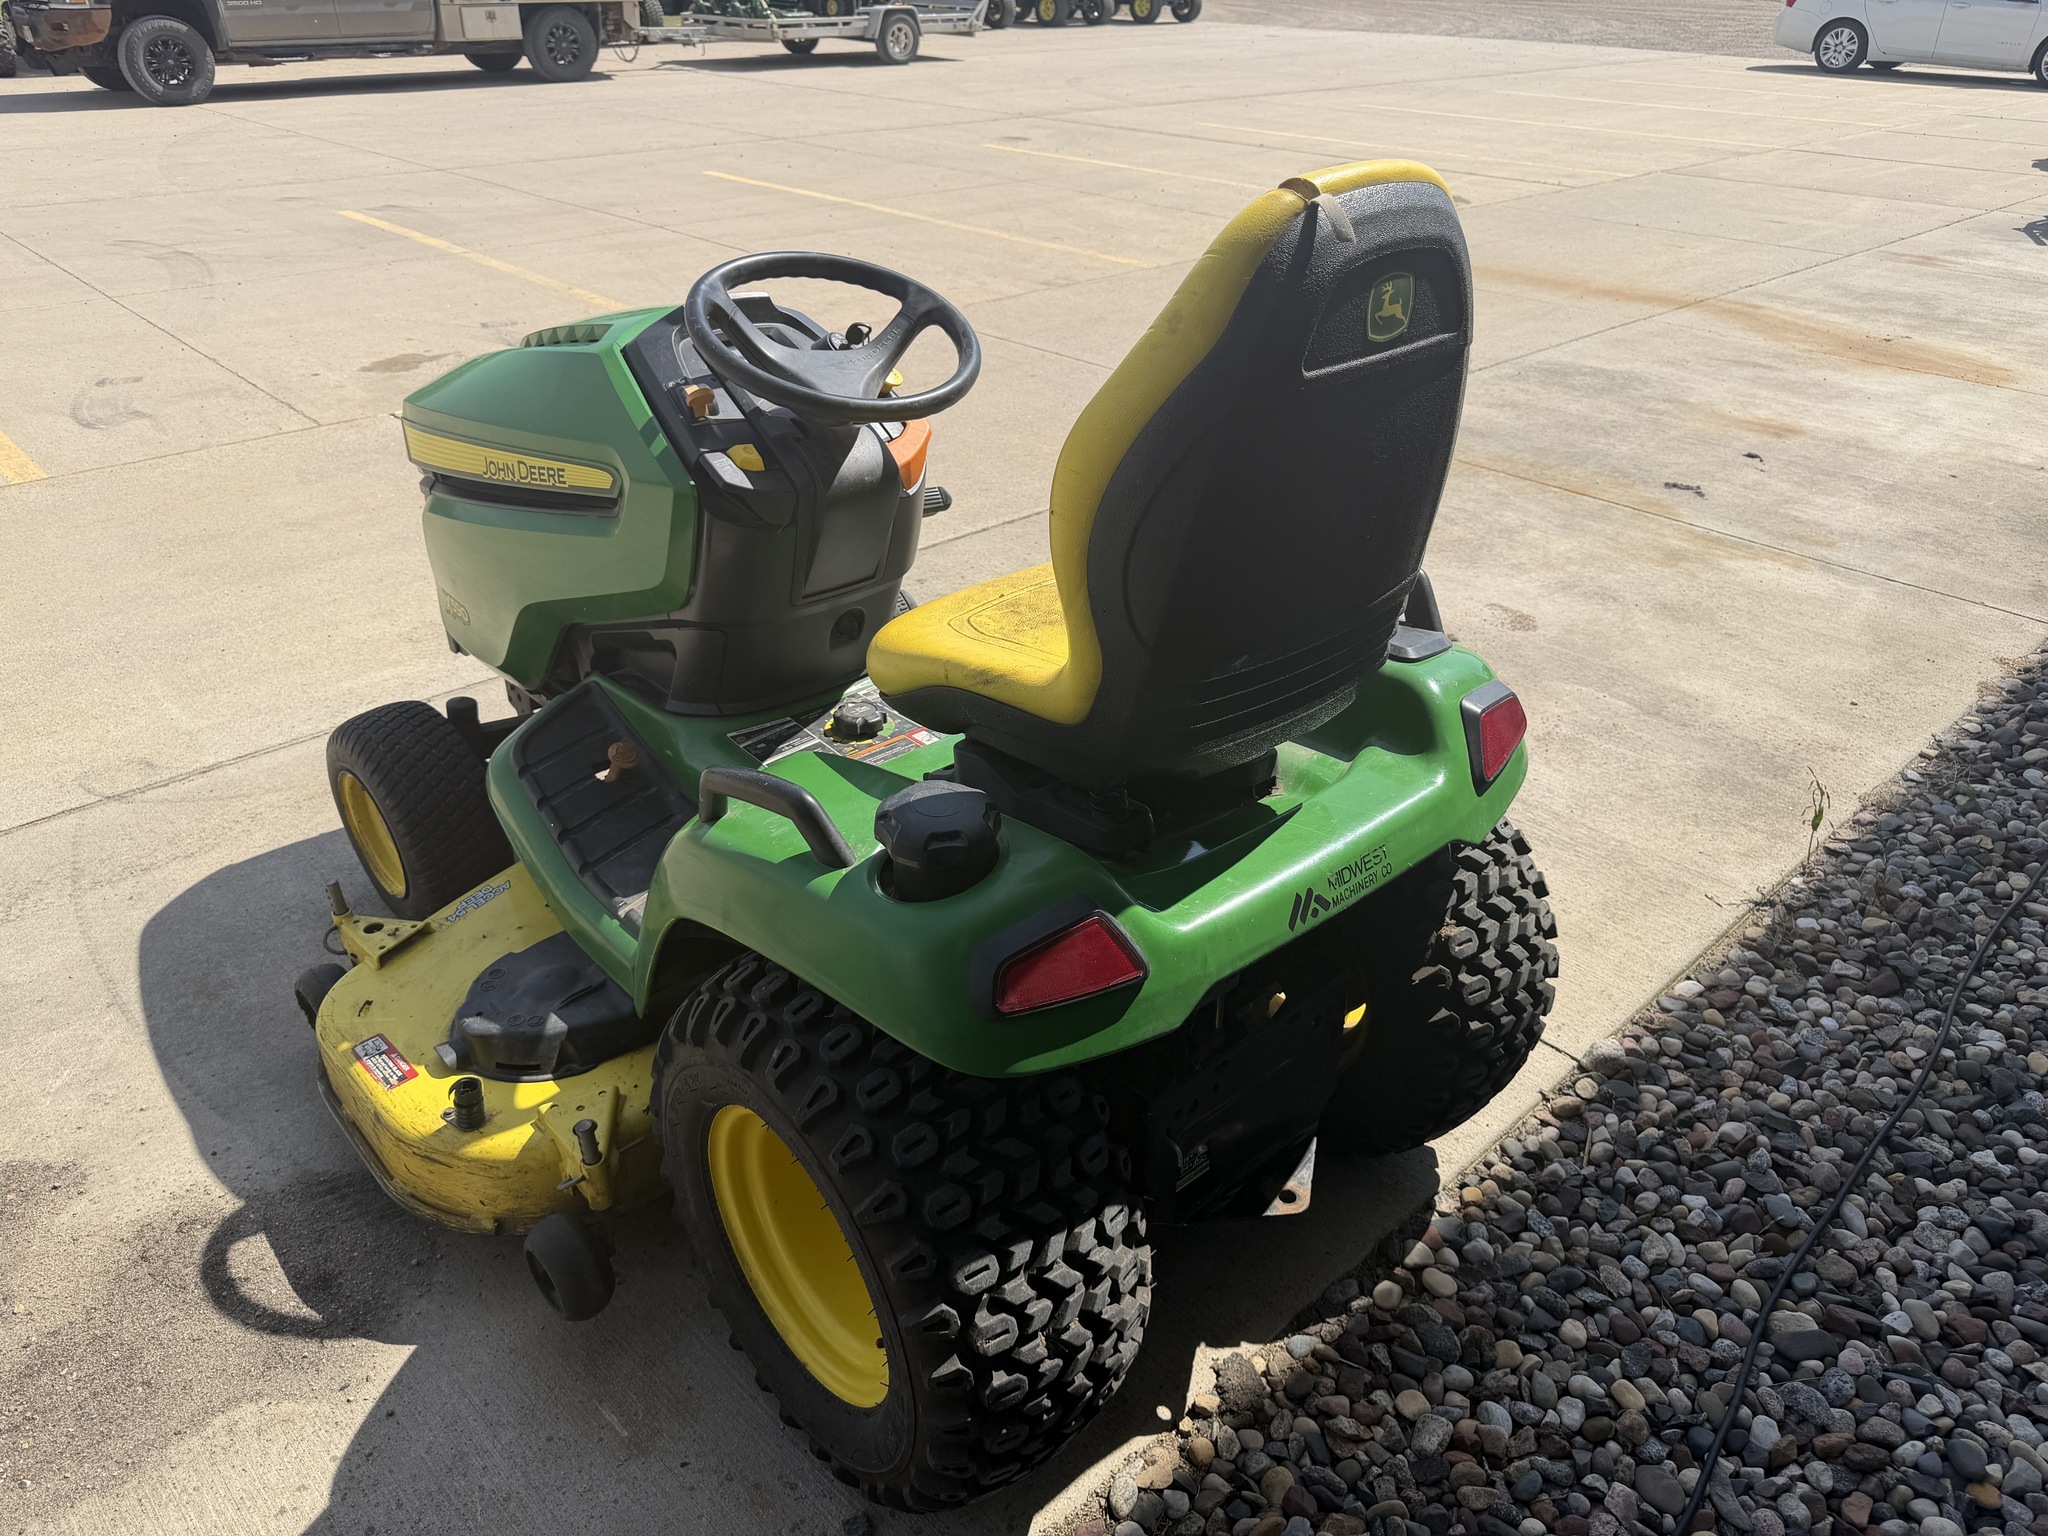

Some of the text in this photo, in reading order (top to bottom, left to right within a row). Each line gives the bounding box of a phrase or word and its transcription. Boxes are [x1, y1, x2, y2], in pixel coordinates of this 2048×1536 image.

[872, 326, 901, 354] DEERE
[482, 456, 568, 485] JOHN DEERE
[1327, 844, 1388, 891] MIDWEST
[456, 885, 494, 911] DEEP
[1332, 862, 1393, 908] MACHINERY CO
[446, 880, 511, 922] ACCEL 54
[394, 1055, 411, 1072] DANGER
